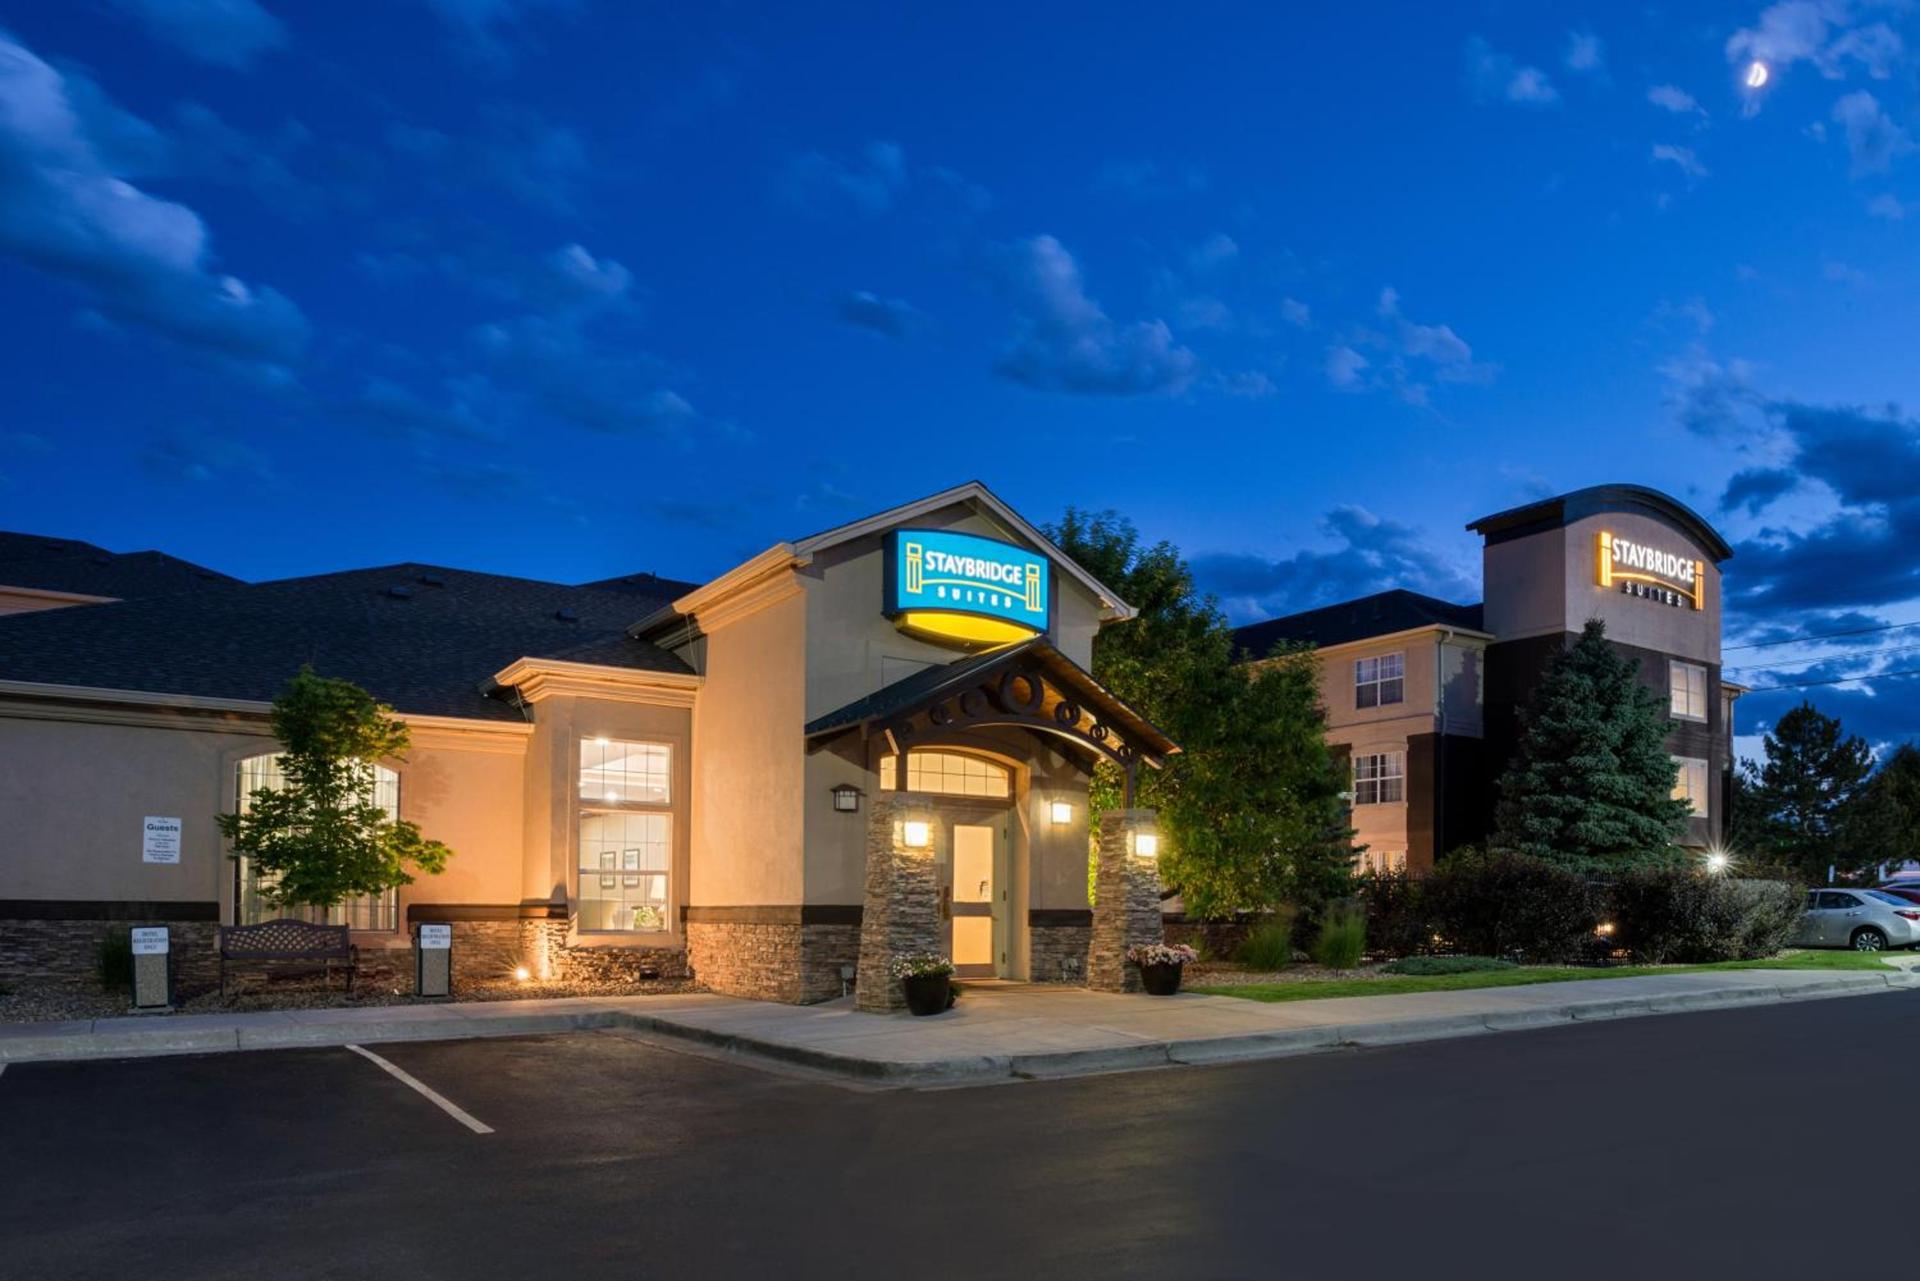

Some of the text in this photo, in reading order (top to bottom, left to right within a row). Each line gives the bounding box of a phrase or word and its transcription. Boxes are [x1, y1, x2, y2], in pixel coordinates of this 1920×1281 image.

[925, 551, 1023, 585] STAYBRIDGE
[1612, 538, 1695, 583] STAYBRIDGE
[937, 585, 1012, 609] SUITES
[1625, 580, 1682, 607] SUITES
[146, 823, 179, 832] Guests
